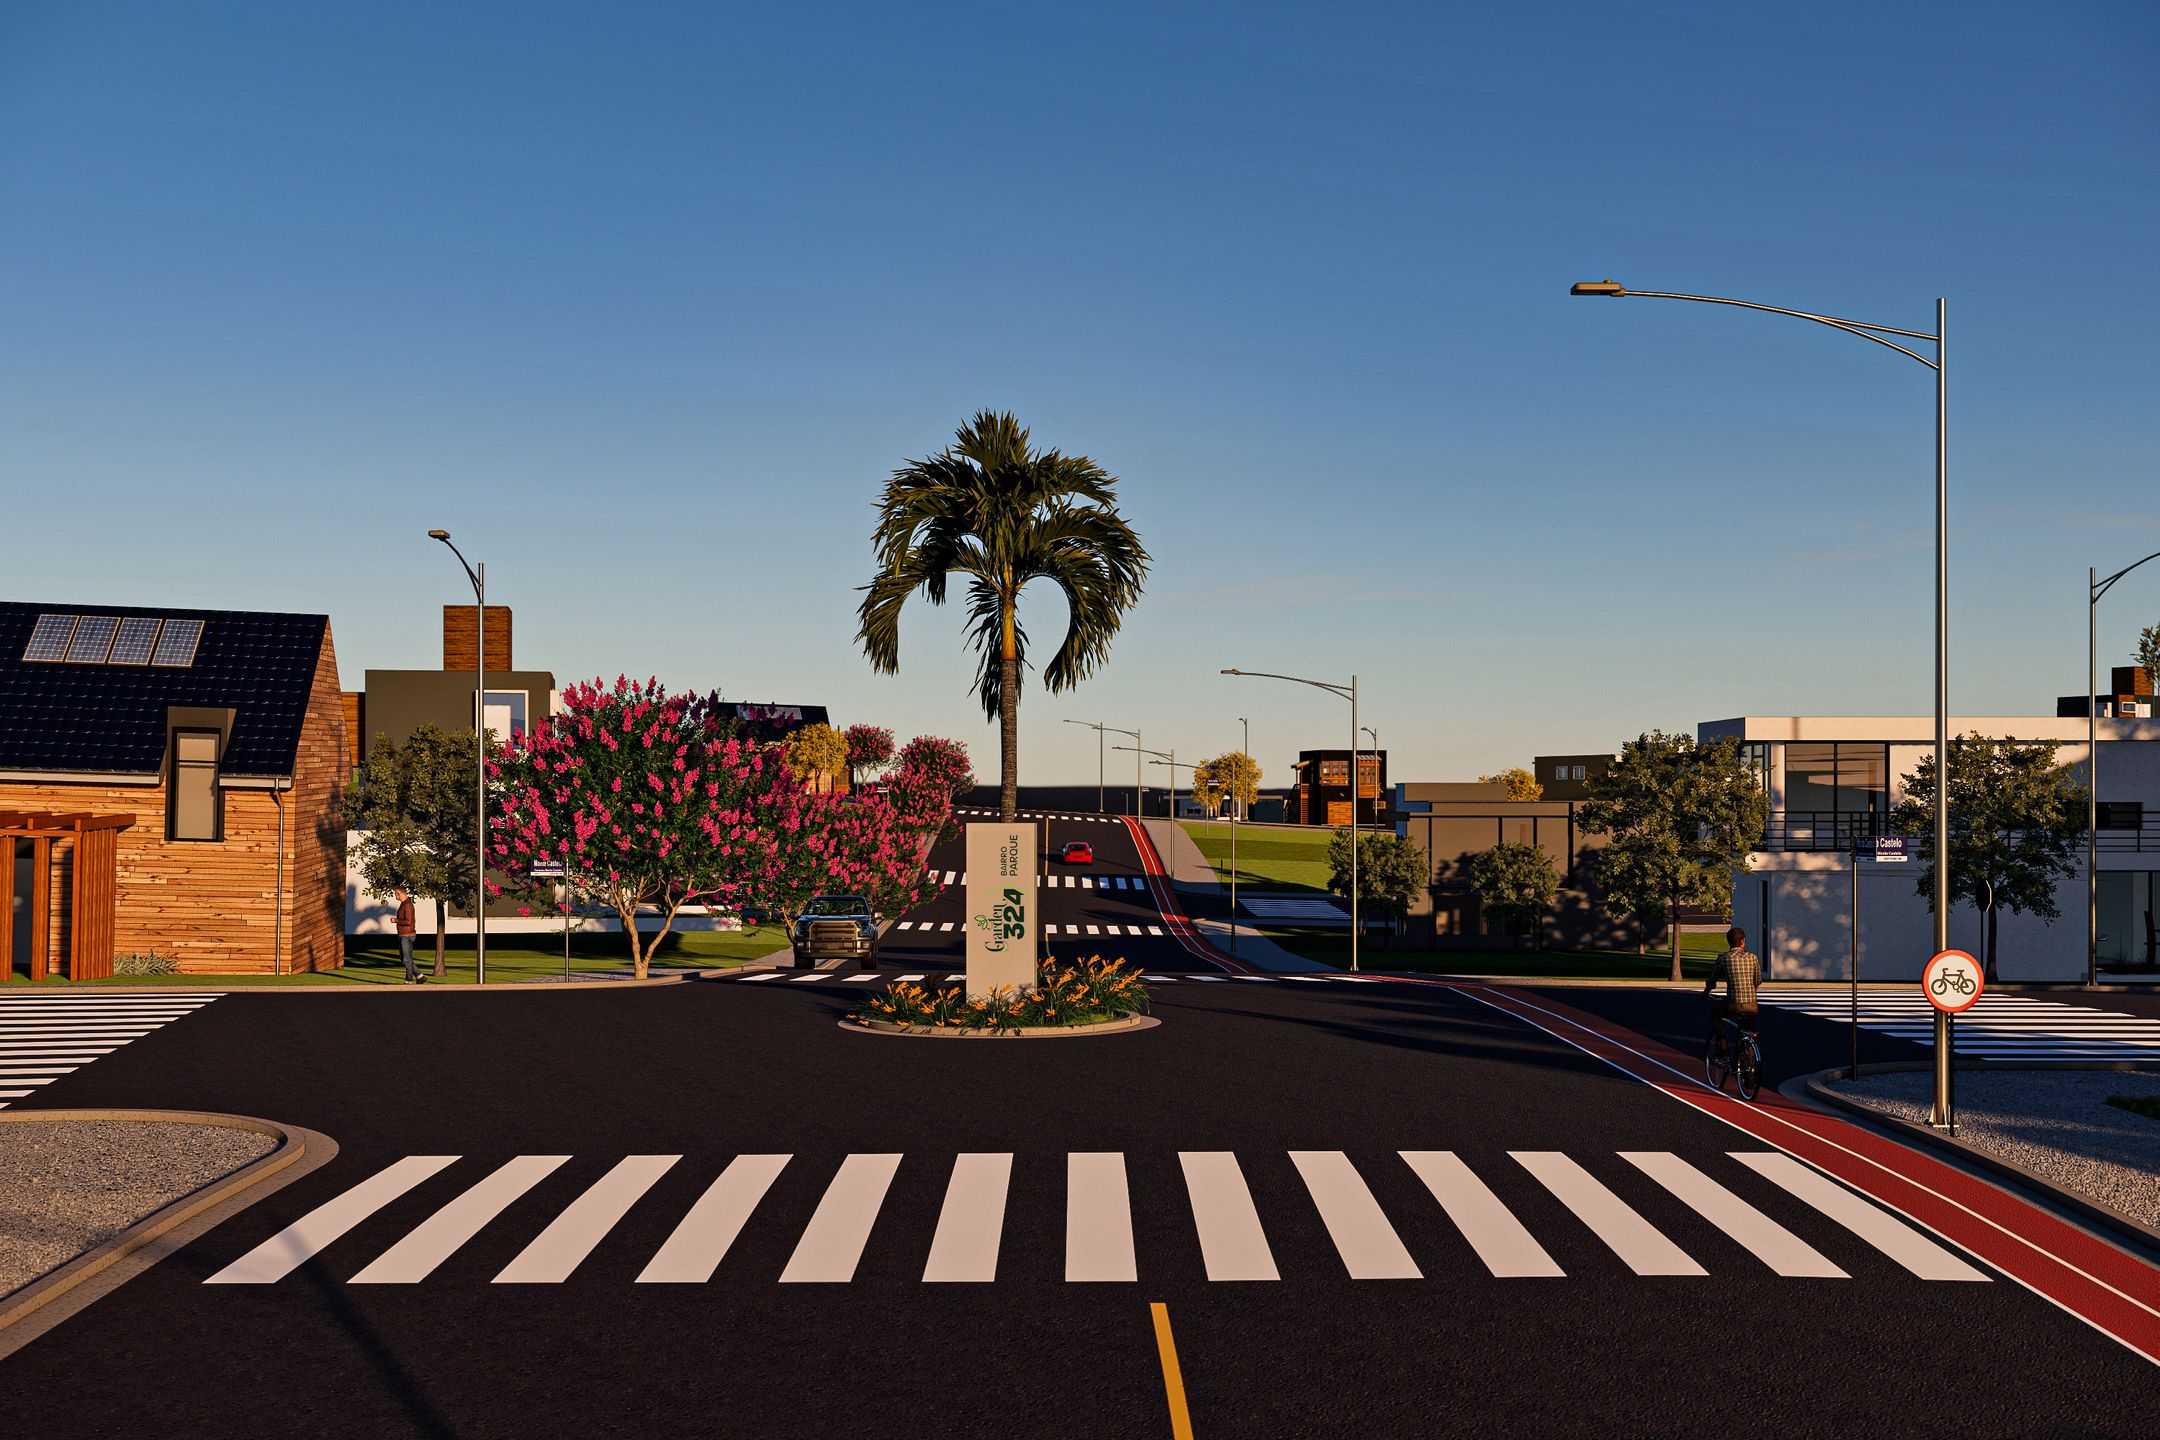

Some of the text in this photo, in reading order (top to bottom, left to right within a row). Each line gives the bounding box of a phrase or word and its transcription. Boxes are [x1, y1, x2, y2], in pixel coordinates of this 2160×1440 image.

[1009, 835, 1018, 876] PARQUE
[1880, 837, 1903, 848] Castelo
[984, 898, 1008, 952] Garden
[1003, 888, 1025, 940] 324
